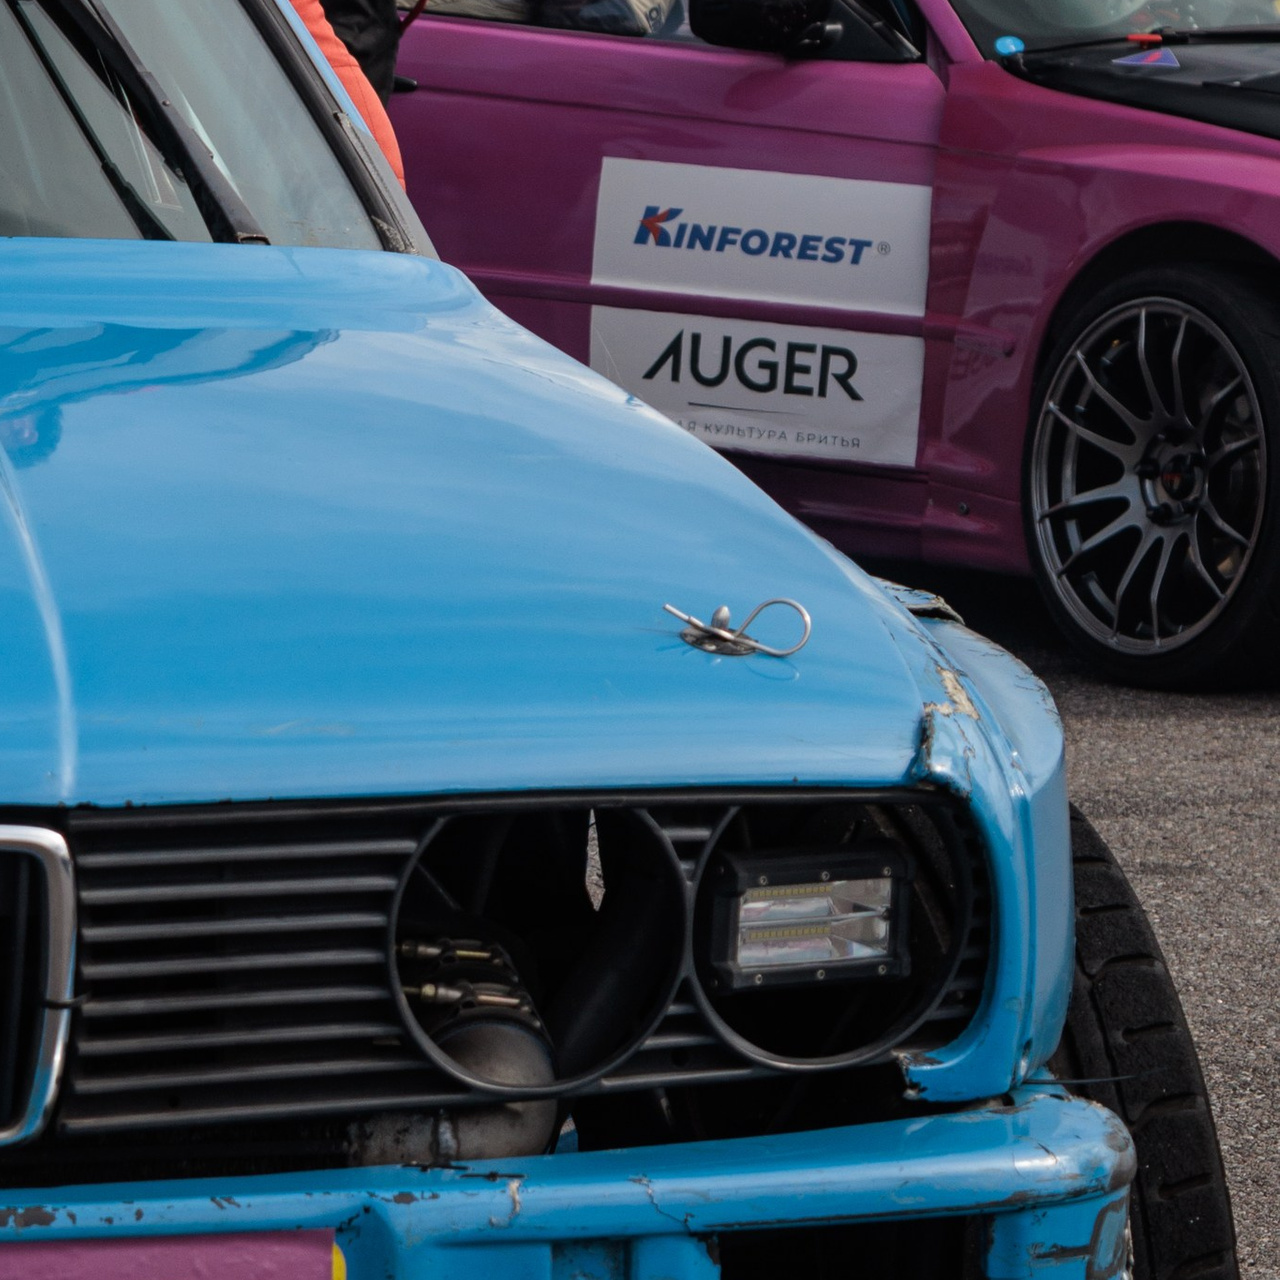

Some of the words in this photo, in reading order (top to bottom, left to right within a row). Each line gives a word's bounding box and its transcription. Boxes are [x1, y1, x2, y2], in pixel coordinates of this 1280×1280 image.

[642, 329, 864, 401] AUGER
[704, 422, 788, 441] КУЛЬТУРА
[796, 431, 861, 449] БРИТЬЯ
